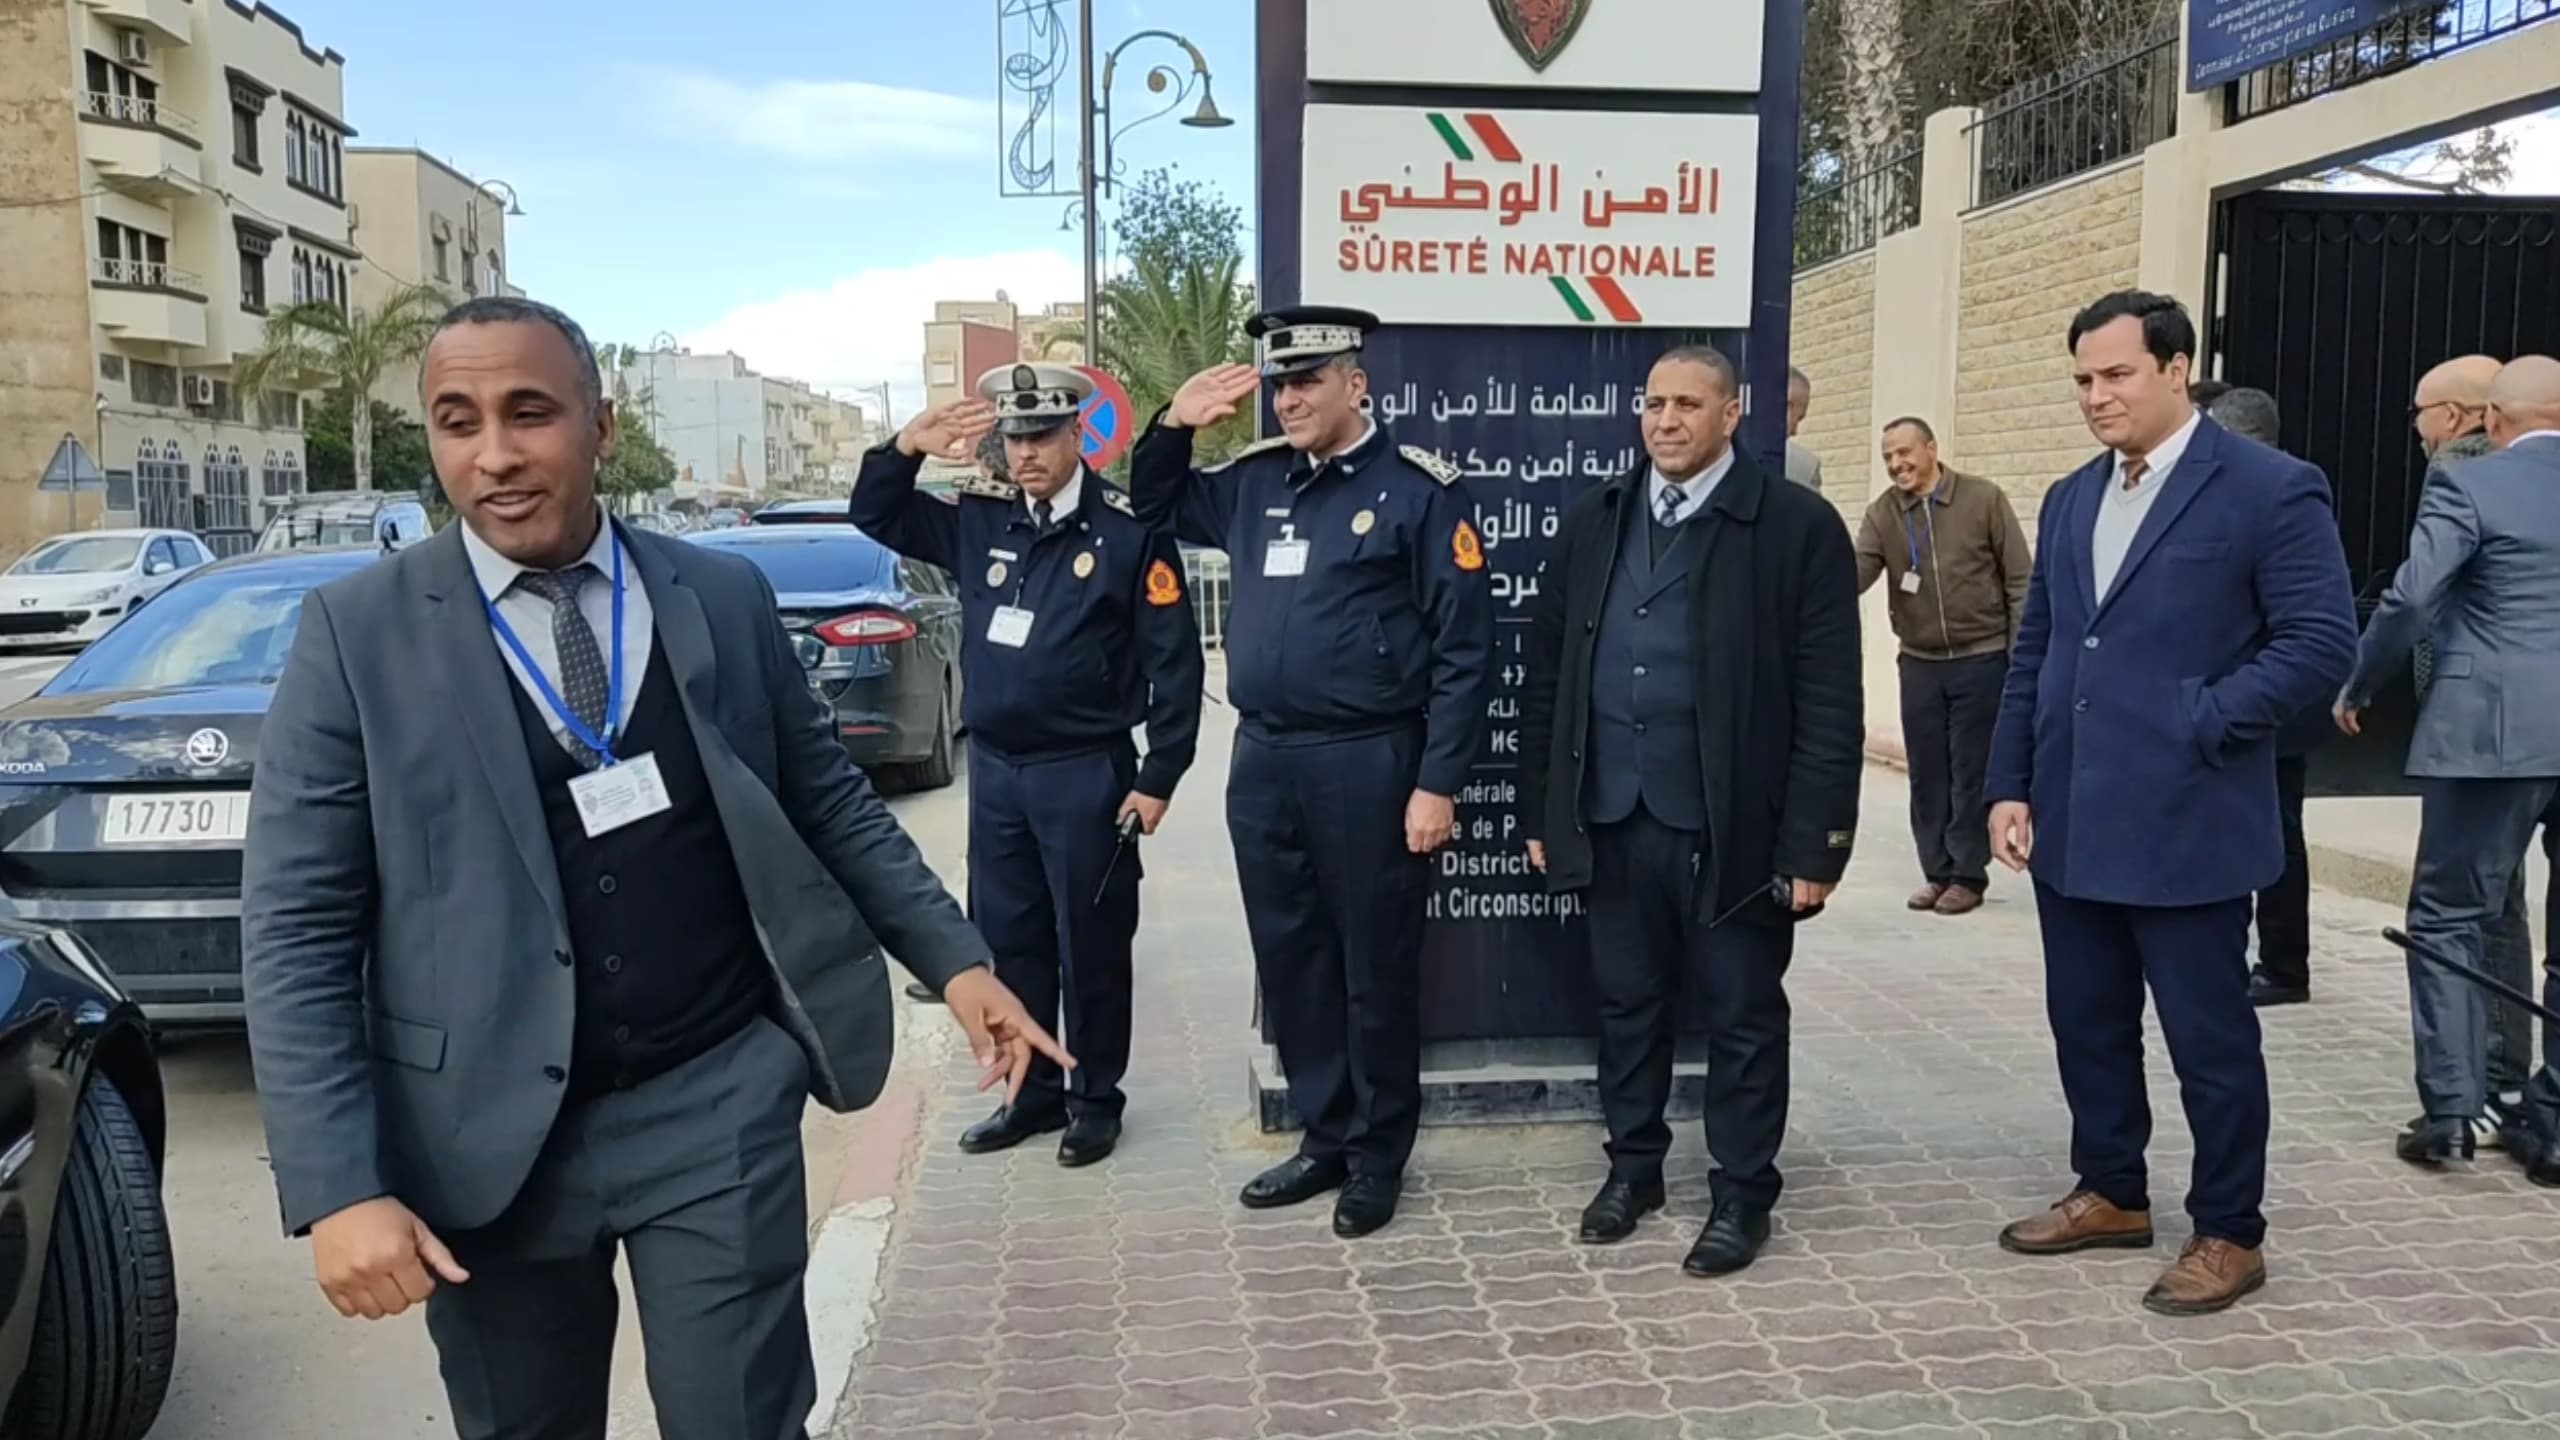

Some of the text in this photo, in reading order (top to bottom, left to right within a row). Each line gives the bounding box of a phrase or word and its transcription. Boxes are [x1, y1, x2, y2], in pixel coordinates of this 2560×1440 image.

[1339, 161, 1720, 234] الأمن الوطني
[1337, 234, 1718, 279] SÛRETÉ NATIONALE
[1431, 376, 1517, 422] للأمن
[1529, 382, 1618, 416] العامة
[1519, 439, 1574, 482] أمن
[1581, 447, 1635, 482] لاية
[1474, 498, 1531, 549] الأول
[0, 761, 47, 775] KODA
[1453, 779, 1517, 804] nérale
[123, 799, 215, 835] 17730
[1472, 815, 1494, 840] de
[1442, 850, 1531, 877] District
[1448, 886, 1588, 927] Circonscript
